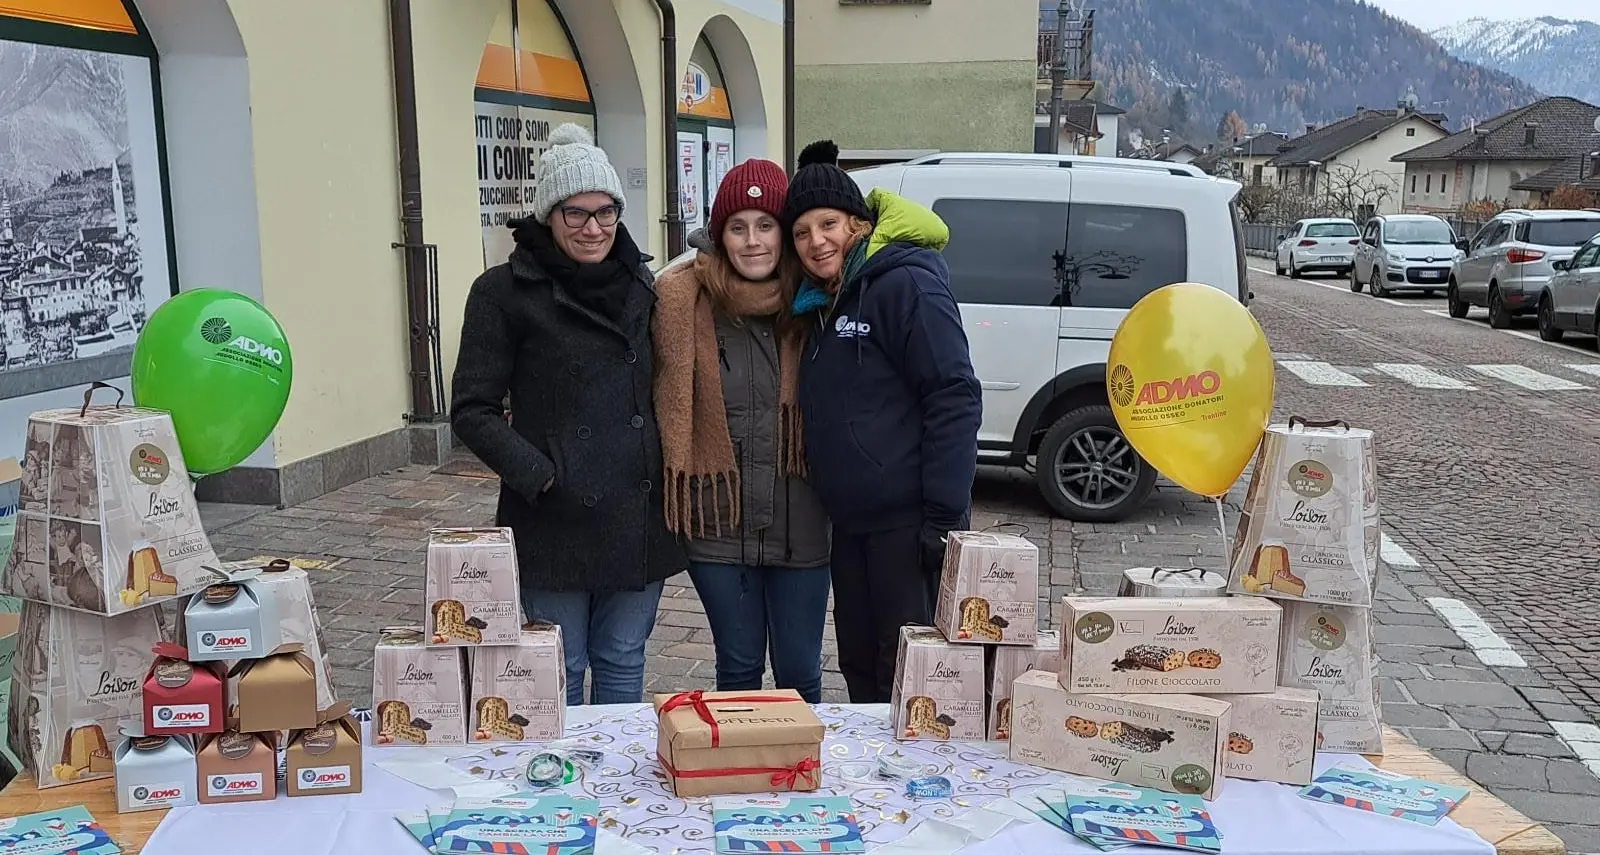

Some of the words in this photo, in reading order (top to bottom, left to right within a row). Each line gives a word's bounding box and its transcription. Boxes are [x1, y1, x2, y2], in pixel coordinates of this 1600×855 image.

[496, 117, 521, 139] COOP
[526, 119, 550, 141] SONO
[493, 145, 535, 181] COME
[228, 336, 282, 365] ADMO
[1135, 370, 1221, 406] ADMO
[1132, 404, 1183, 415] ASSOCIAZIONE
[1185, 395, 1224, 409] DONATORI
[1160, 411, 1186, 420] OSSEO
[1201, 410, 1228, 421] Trentino
[144, 491, 180, 519] Loison
[1283, 500, 1329, 524] Loison
[168, 543, 203, 558] CLASSICO
[1301, 554, 1344, 566] CLASSICO
[452, 561, 489, 579] Loison
[982, 561, 1015, 579] Loison
[1156, 615, 1197, 635] Loison
[216, 636, 247, 646] ADMO
[398, 663, 433, 681] Loison
[498, 659, 533, 678] Loison
[928, 661, 961, 678] Loison
[1301, 656, 1342, 678] Loison
[90, 670, 139, 697] Loison
[1127, 677, 1158, 687] FILONE
[1161, 677, 1222, 687] CIOCCOLATO
[172, 711, 205, 720] ADMO
[1066, 699, 1125, 716] CIOCCOLATO
[1128, 708, 1160, 722] FILONE
[1319, 708, 1359, 718] CLASSICO
[716, 717, 797, 725] OFFERTA
[1090, 753, 1128, 777] Loison
[226, 780, 258, 789] ADMO
[315, 773, 346, 782] ADMO
[148, 788, 181, 800] ADMO
